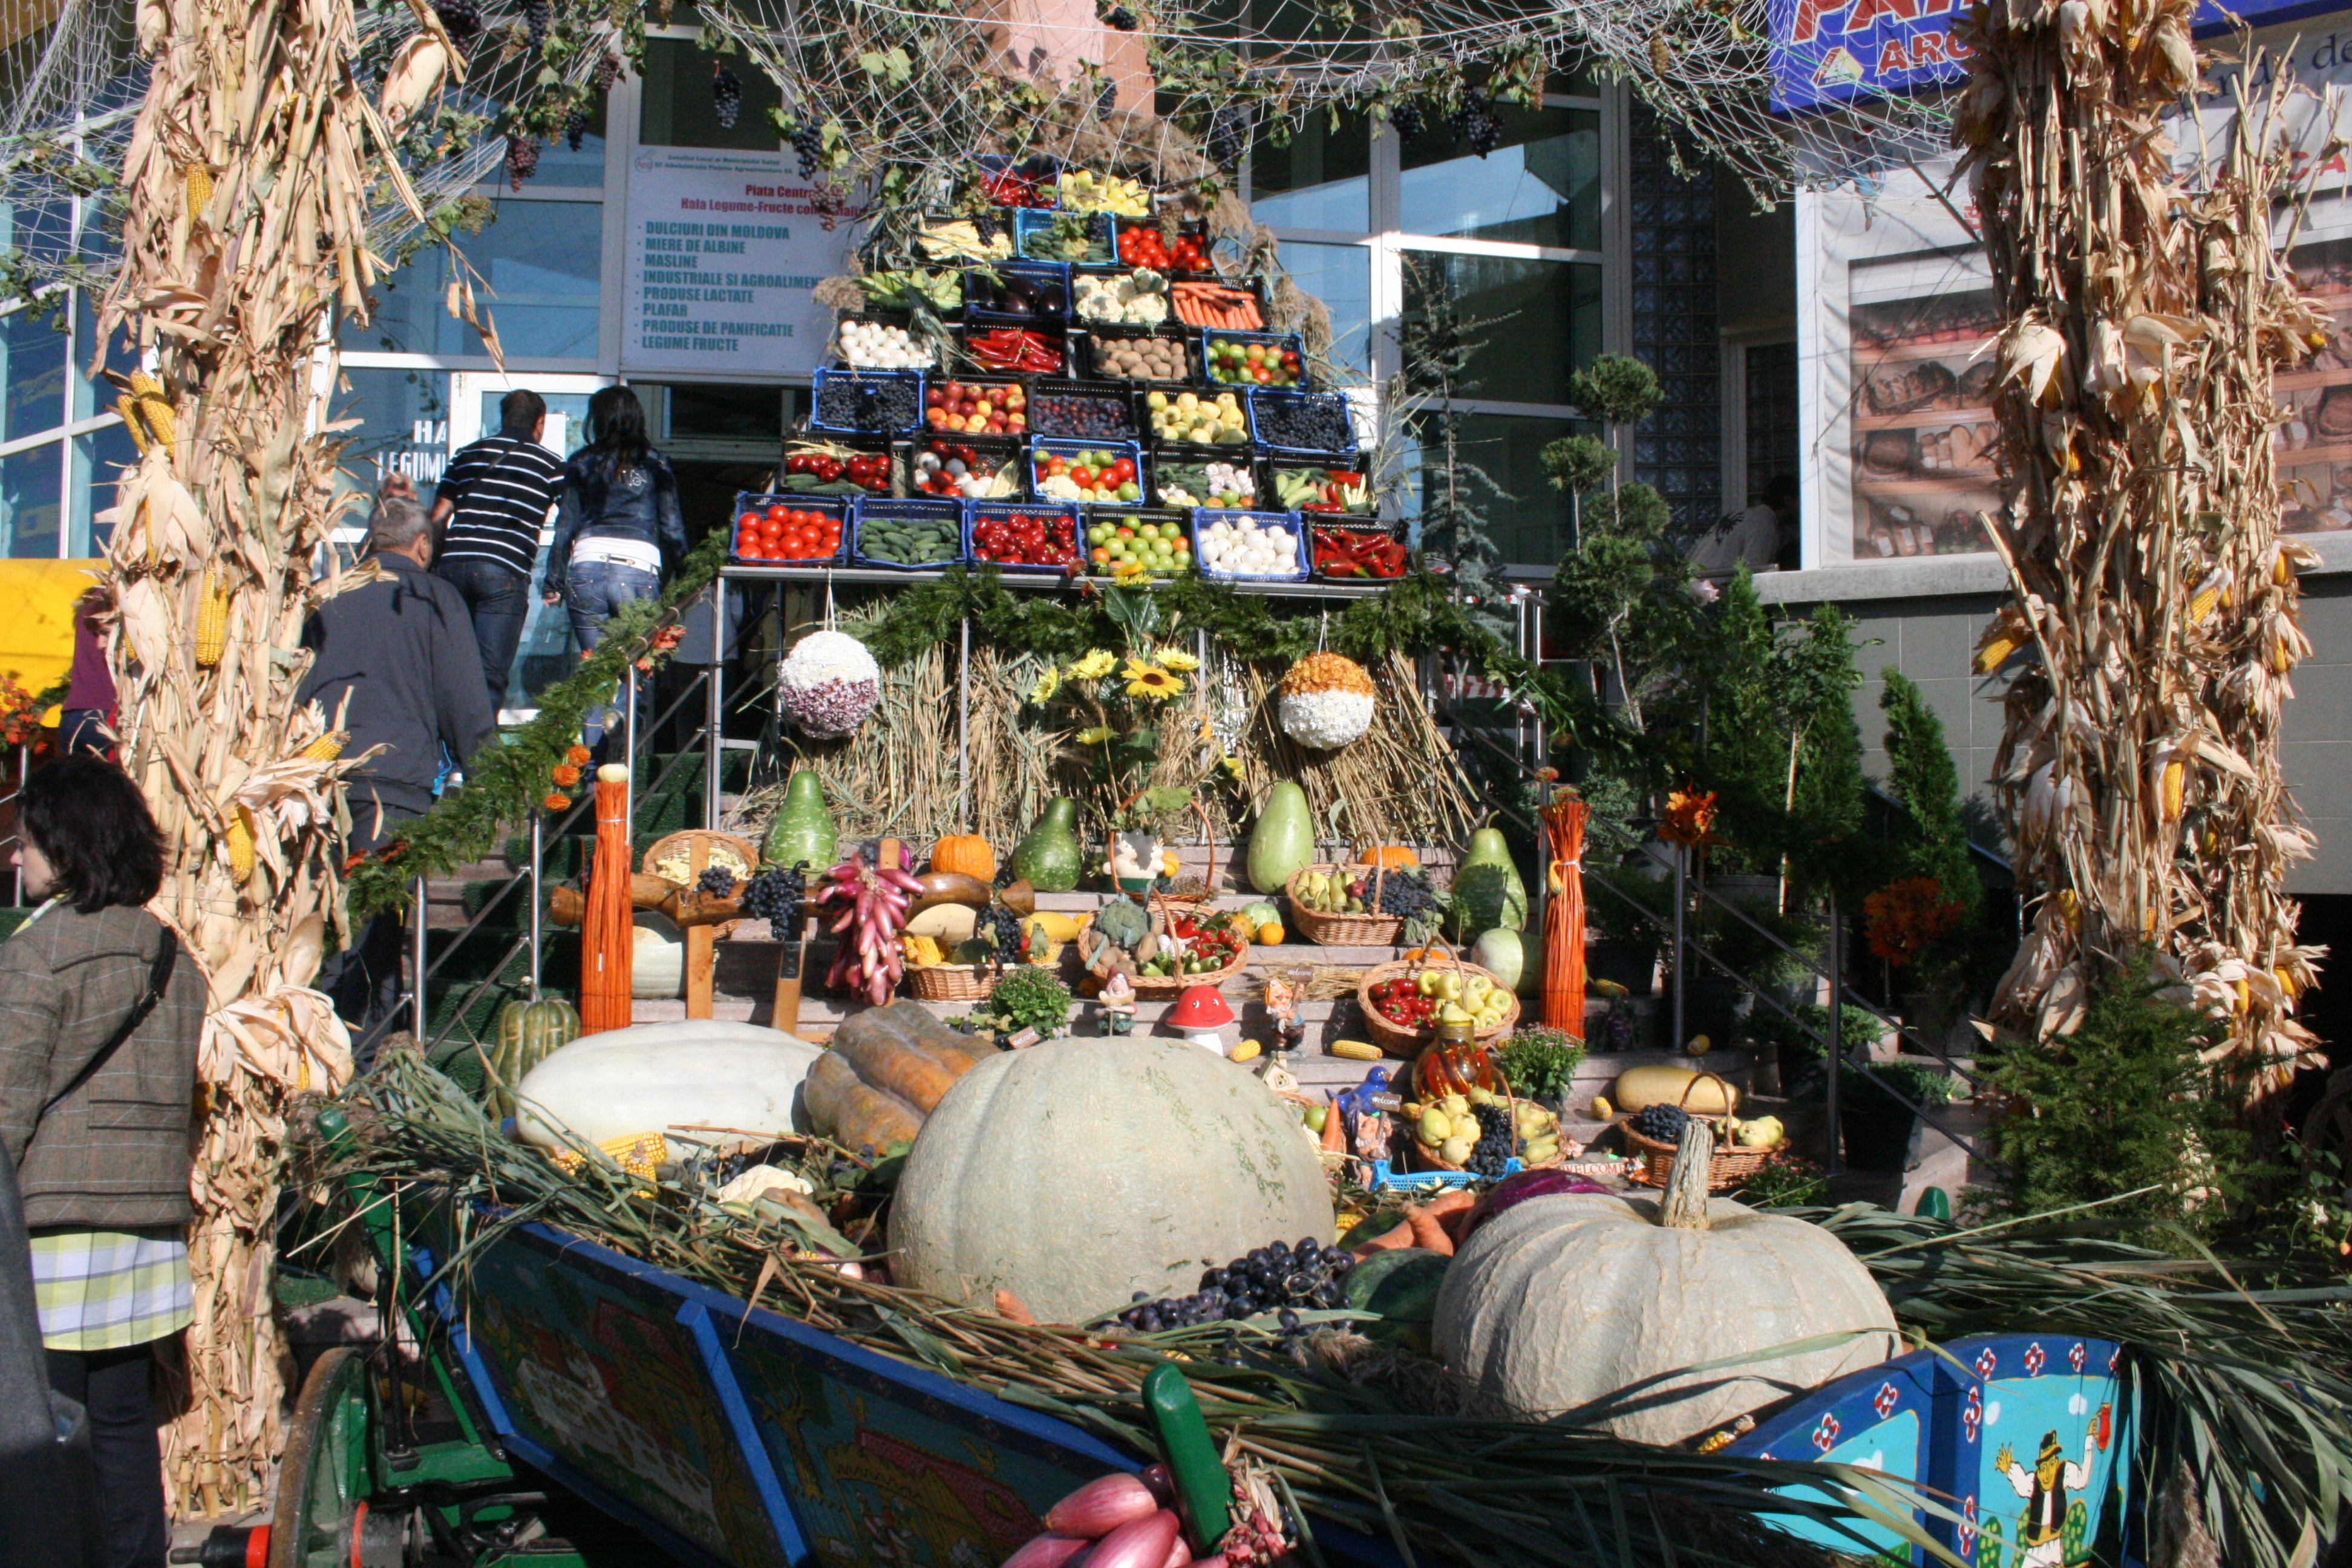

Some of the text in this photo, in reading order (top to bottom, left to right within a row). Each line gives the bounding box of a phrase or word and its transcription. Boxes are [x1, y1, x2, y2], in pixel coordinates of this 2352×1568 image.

[1875, 31, 1981, 77] ARC
[746, 185, 812, 199] Piata Centr
[681, 198, 707, 211] Hala
[709, 198, 794, 215] Legume-Fructe
[645, 221, 790, 240] DULCIURI DIN MOLDOVA
[645, 238, 746, 254] MIERE DE ALBINE
[645, 254, 698, 268] MASLINE
[644, 270, 825, 289] INDUSTRIALE SI AGROALIMEN
[644, 286, 754, 303] PRODUSE LACTATE
[643, 302, 688, 317] PLAFAR
[642, 319, 794, 338] PRODUSE DE PANIFICATIE
[642, 336, 739, 351] LEGUME FRUCTE
[414, 420, 447, 444] HA
[1561, 1163, 1625, 1174] WELCOME
